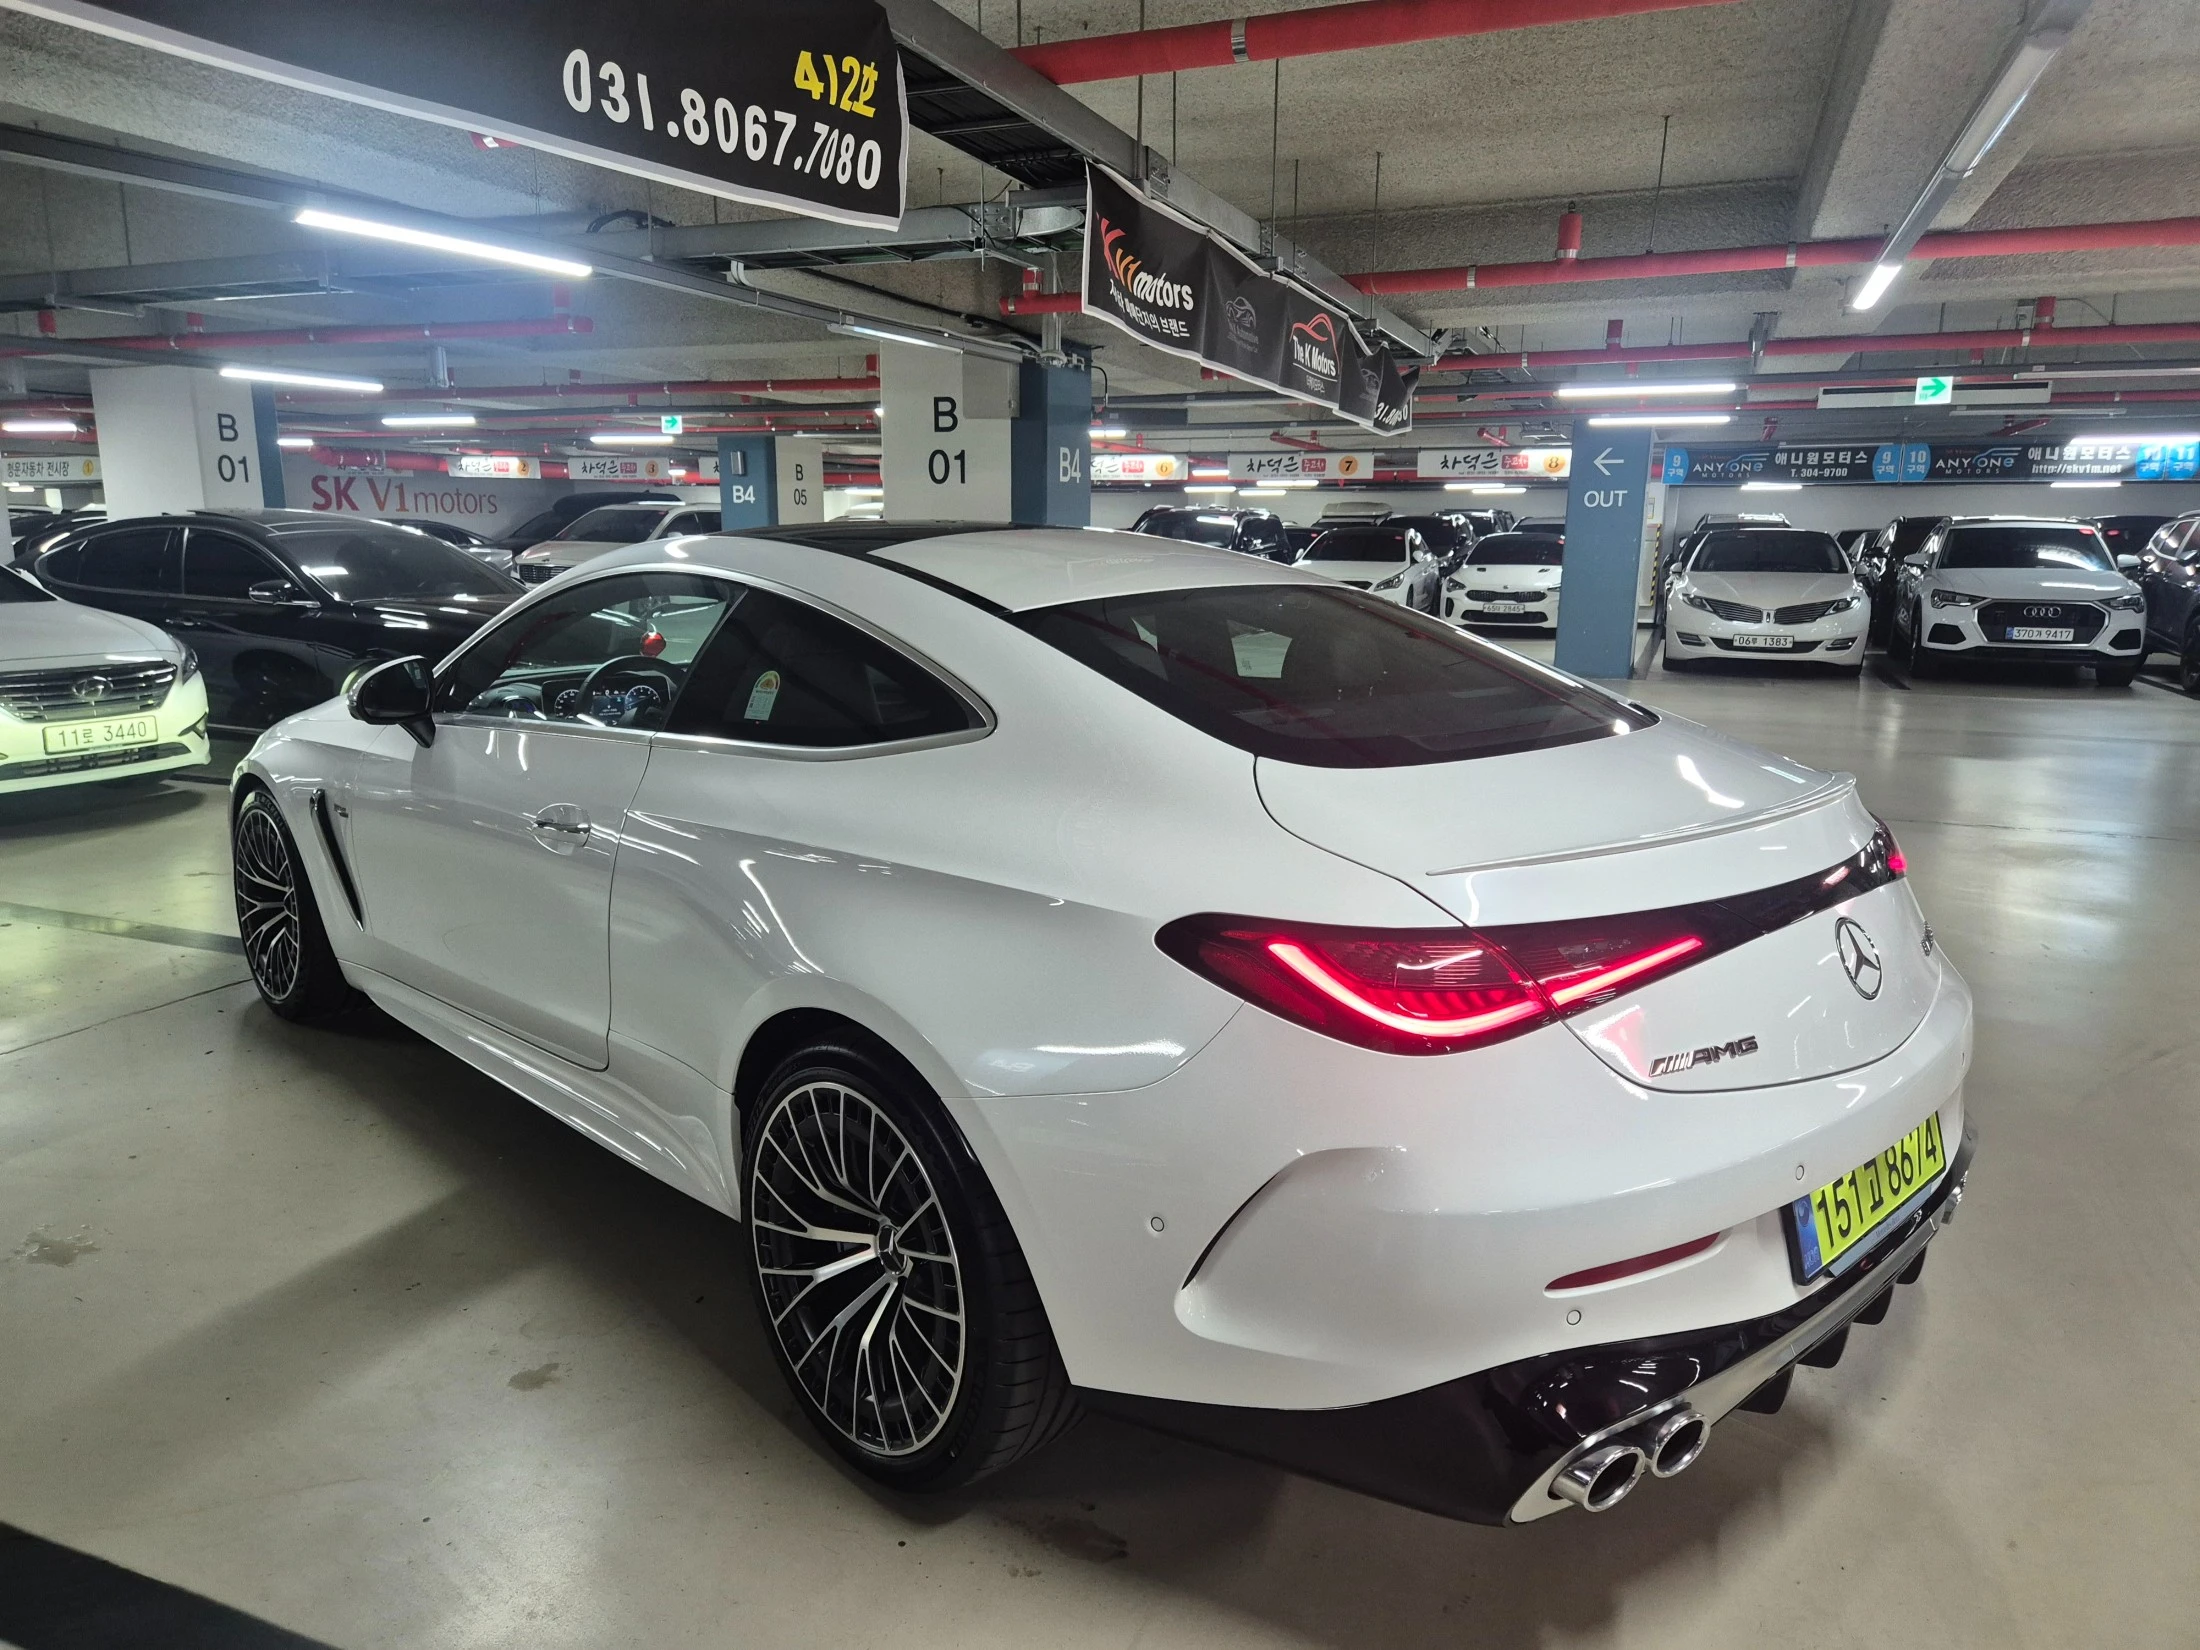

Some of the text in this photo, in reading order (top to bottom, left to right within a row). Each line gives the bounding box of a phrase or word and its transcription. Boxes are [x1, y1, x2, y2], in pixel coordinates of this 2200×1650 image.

[562, 48, 882, 190] 031.8067.7080
[1133, 271, 1194, 310] motors
[1160, 317, 1190, 337] 브랜드
[1293, 335, 1337, 377] The K Motors
[933, 396, 959, 433] B
[217, 413, 239, 442] B
[1440, 452, 1559, 471] 차덕근 중고차 8
[1673, 454, 1681, 467] 9
[1775, 451, 1868, 466] 애니원모터스
[1882, 451, 1892, 464] 9
[1910, 450, 1927, 464] 10
[2028, 446, 2131, 461] 애니원모터스
[2176, 446, 2195, 461] 11
[47, 461, 70, 477] 전시장
[218, 454, 249, 483] 01
[520, 462, 527, 472] 2
[581, 460, 619, 474] 차덕근
[649, 464, 655, 474] 3
[795, 463, 804, 481] B
[928, 449, 966, 485] 01
[1059, 447, 1082, 484] B4
[1160, 464, 1168, 473] 6
[1247, 456, 1353, 473] 차덕근 중고차 7
[1667, 468, 1684, 477] 구역
[1791, 468, 1848, 477] T. 304-9700
[1876, 465, 1895, 475] 구역
[1907, 464, 1926, 474] 구역
[2140, 463, 2161, 473] 구역
[2173, 461, 2194, 472] 구역
[311, 475, 360, 512] SK
[732, 485, 756, 504] B4
[794, 488, 808, 506] 05
[1583, 490, 1628, 508] OUT
[1692, 1035, 1759, 1067] AMG
